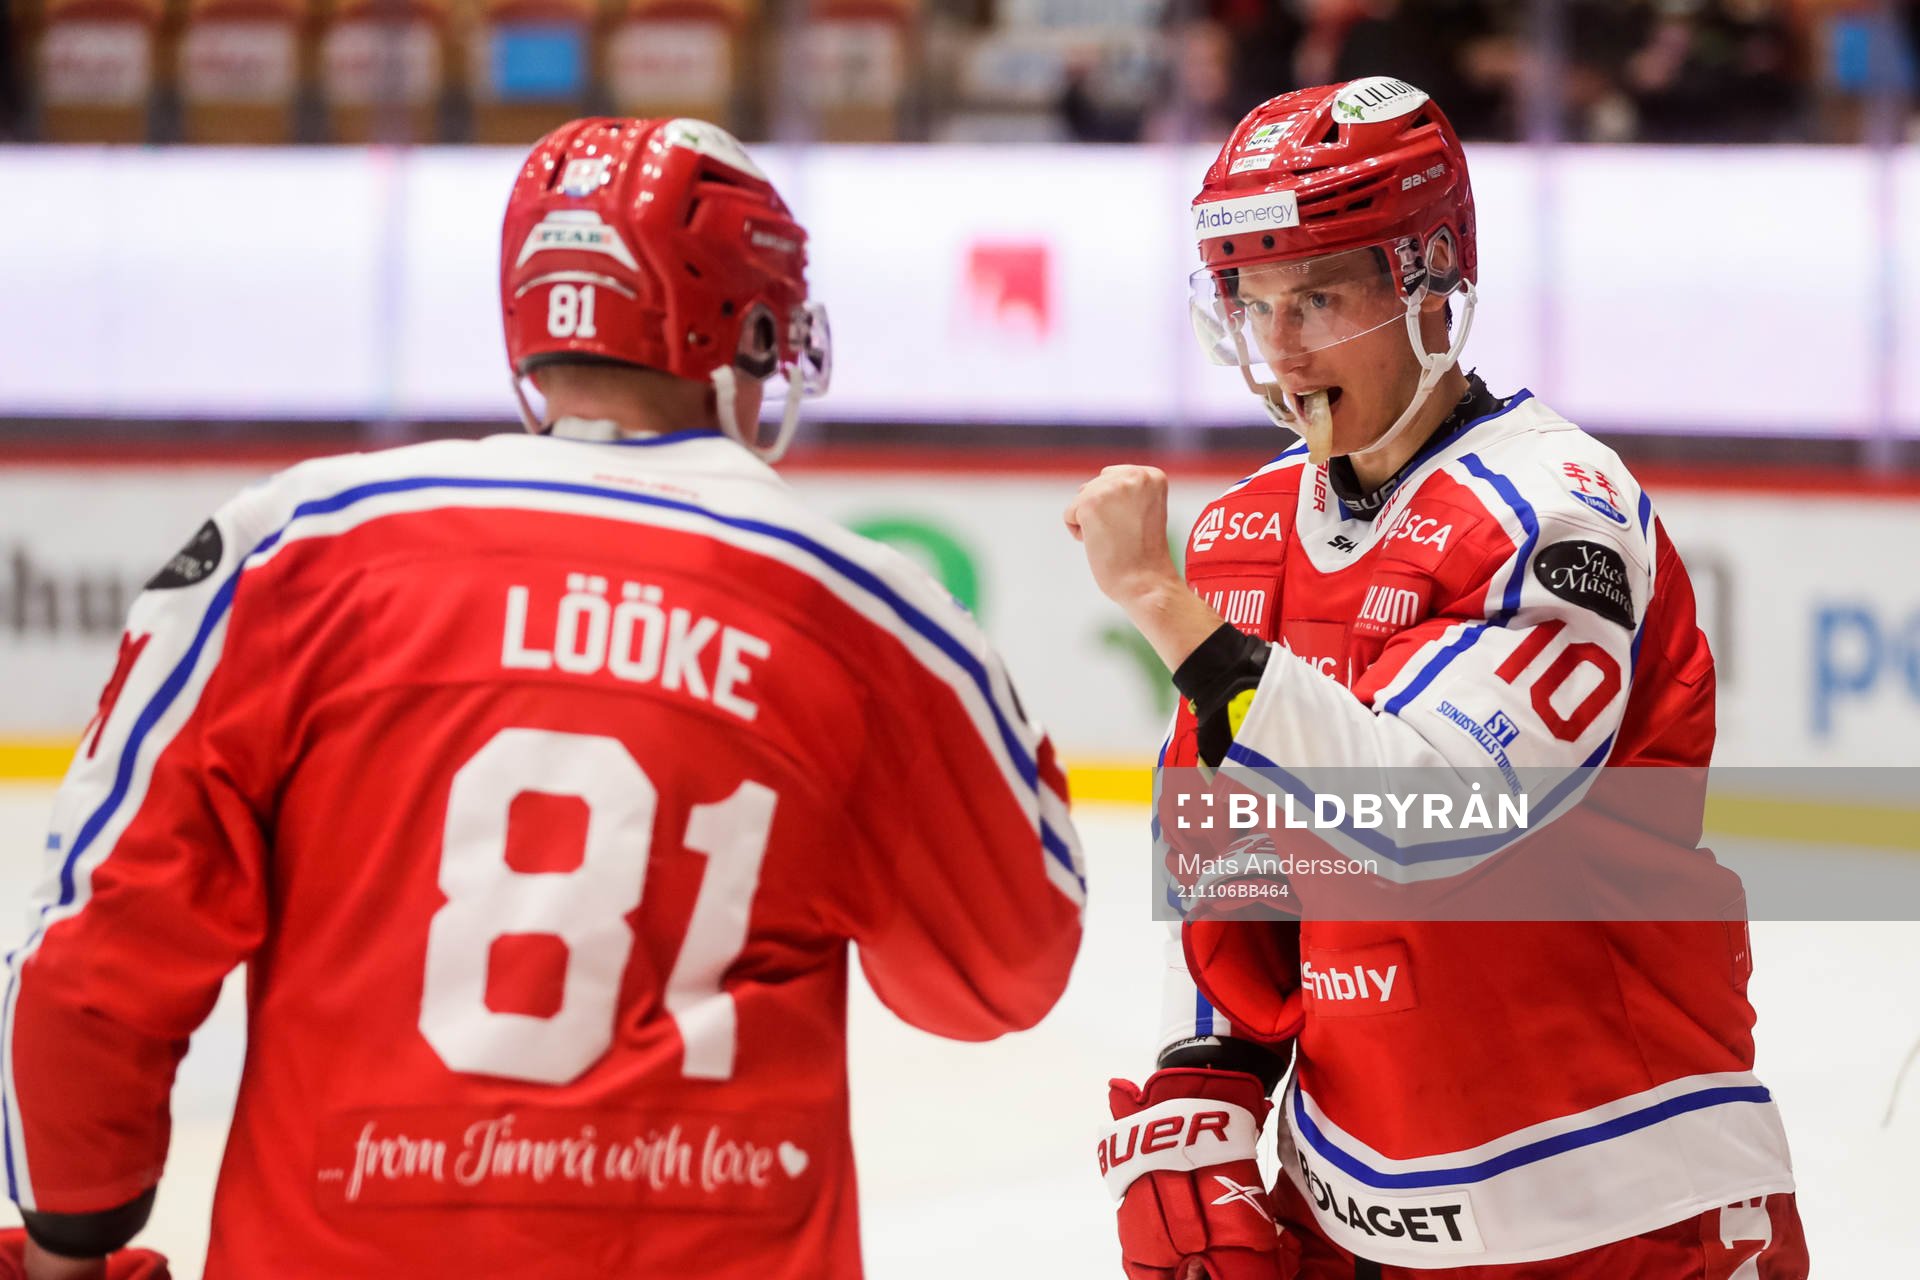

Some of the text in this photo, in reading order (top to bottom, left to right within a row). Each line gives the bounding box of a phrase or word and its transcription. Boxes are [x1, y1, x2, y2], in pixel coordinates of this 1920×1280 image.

[547, 284, 597, 339] 81
[1224, 511, 1282, 541] SCA
[1397, 514, 1453, 552] SCA
[1571, 545, 1624, 585] Yrkes
[501, 573, 771, 721] LÖÖKE
[1494, 618, 1622, 743] 10
[1436, 700, 1499, 755] SUNDSVALLS
[1485, 713, 1518, 746] ST
[418, 727, 779, 1086] 81
[604, 1125, 692, 1191] with
[702, 1125, 774, 1193] love
